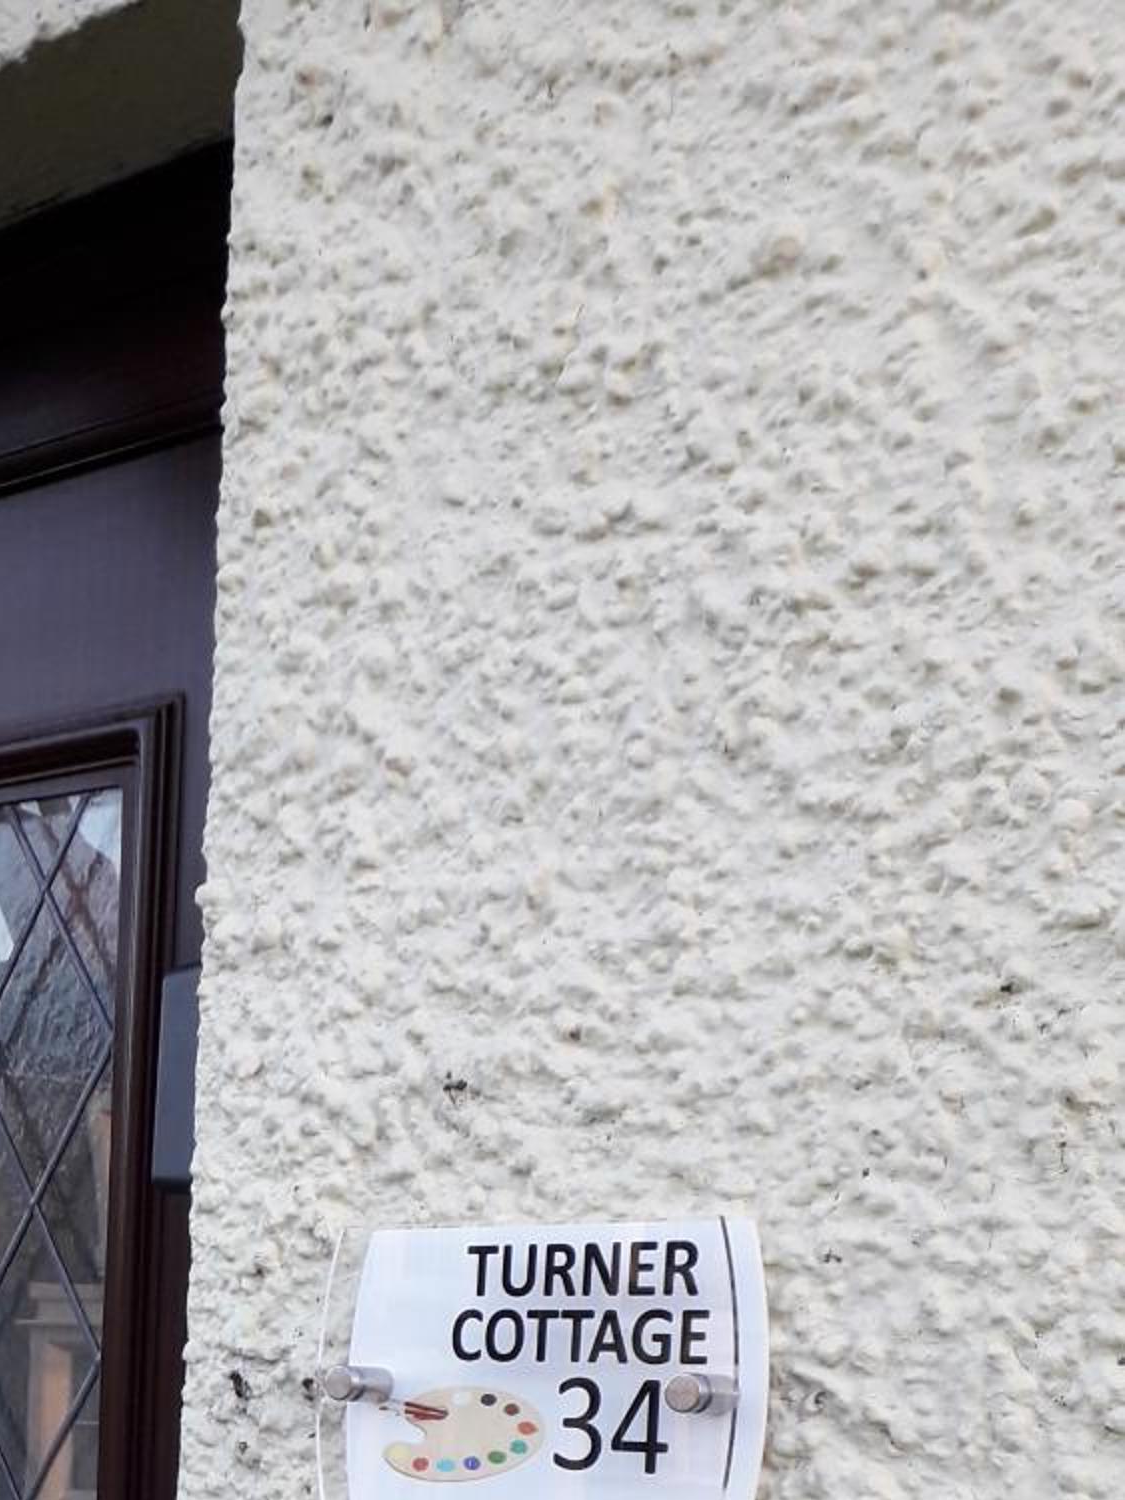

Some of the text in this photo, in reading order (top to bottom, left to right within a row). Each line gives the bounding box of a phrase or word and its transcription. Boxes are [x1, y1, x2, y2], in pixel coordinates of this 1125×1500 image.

[467, 1241, 699, 1297] TURNER
[452, 1309, 710, 1365] COTTAGE
[552, 1377, 669, 1474] 34
